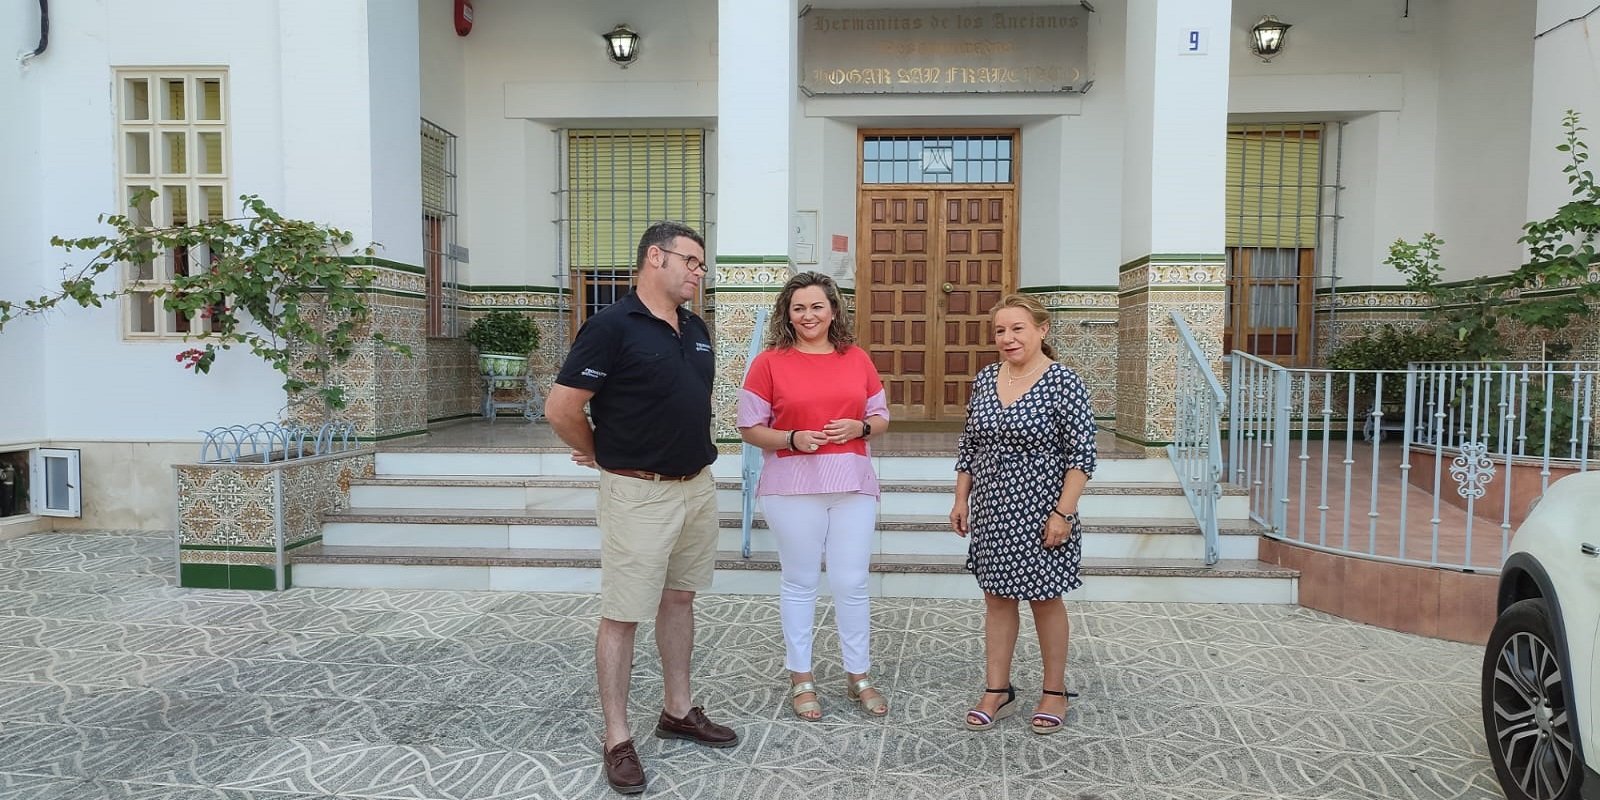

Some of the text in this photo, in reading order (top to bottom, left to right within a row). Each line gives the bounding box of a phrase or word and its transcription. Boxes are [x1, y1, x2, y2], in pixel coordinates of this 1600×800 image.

[814, 12, 1080, 32] Hermanitas de los Ancianos
[1189, 31, 1199, 51] 9
